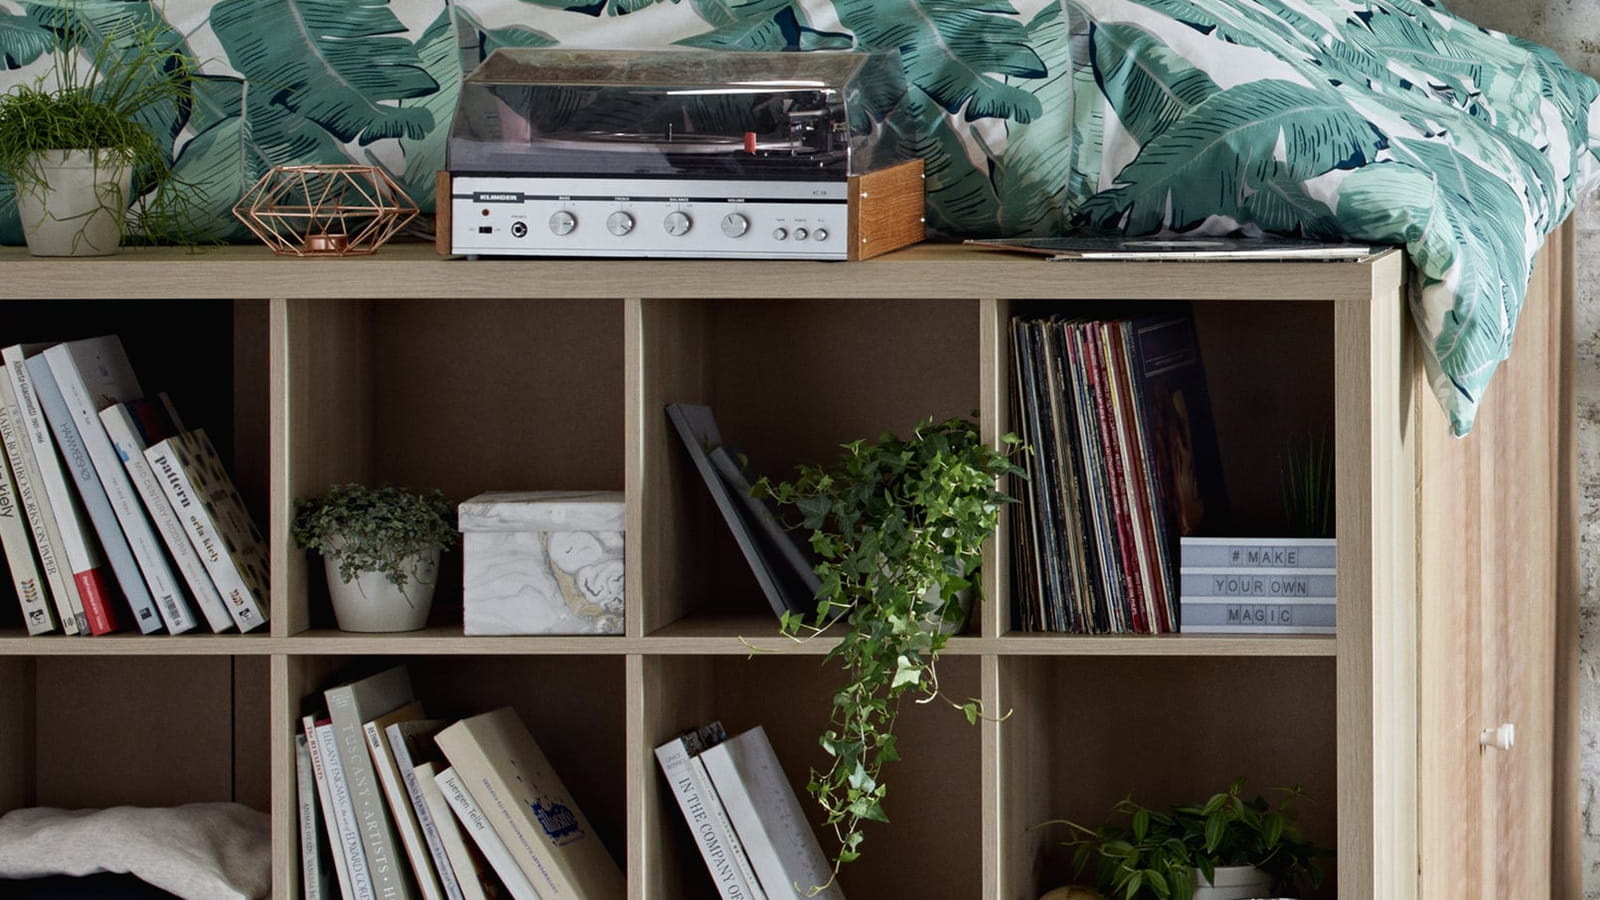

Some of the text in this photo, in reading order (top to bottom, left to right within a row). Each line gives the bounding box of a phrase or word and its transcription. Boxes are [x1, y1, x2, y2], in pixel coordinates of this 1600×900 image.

[7, 440, 28, 487] ROTHKO
[22, 487, 41, 527] WORKS
[154, 455, 192, 509] pattern
[189, 513, 206, 537] orla
[200, 536, 221, 564] kiely
[34, 526, 48, 544] ON
[40, 543, 58, 576] PAPER
[1248, 551, 1296, 564] MAKE
[1215, 580, 1306, 593] YOUR OWN
[1228, 610, 1290, 622] MAGIC
[321, 729, 337, 767] ELEGANT
[345, 830, 363, 873] EDWARD
[343, 723, 369, 797] TUSCANY
[363, 808, 387, 874] ARTISTS
[444, 776, 486, 830] Juergen Teller
[679, 776, 694, 795] IN
[686, 793, 706, 823] THE
[699, 823, 735, 882] COMPANY
